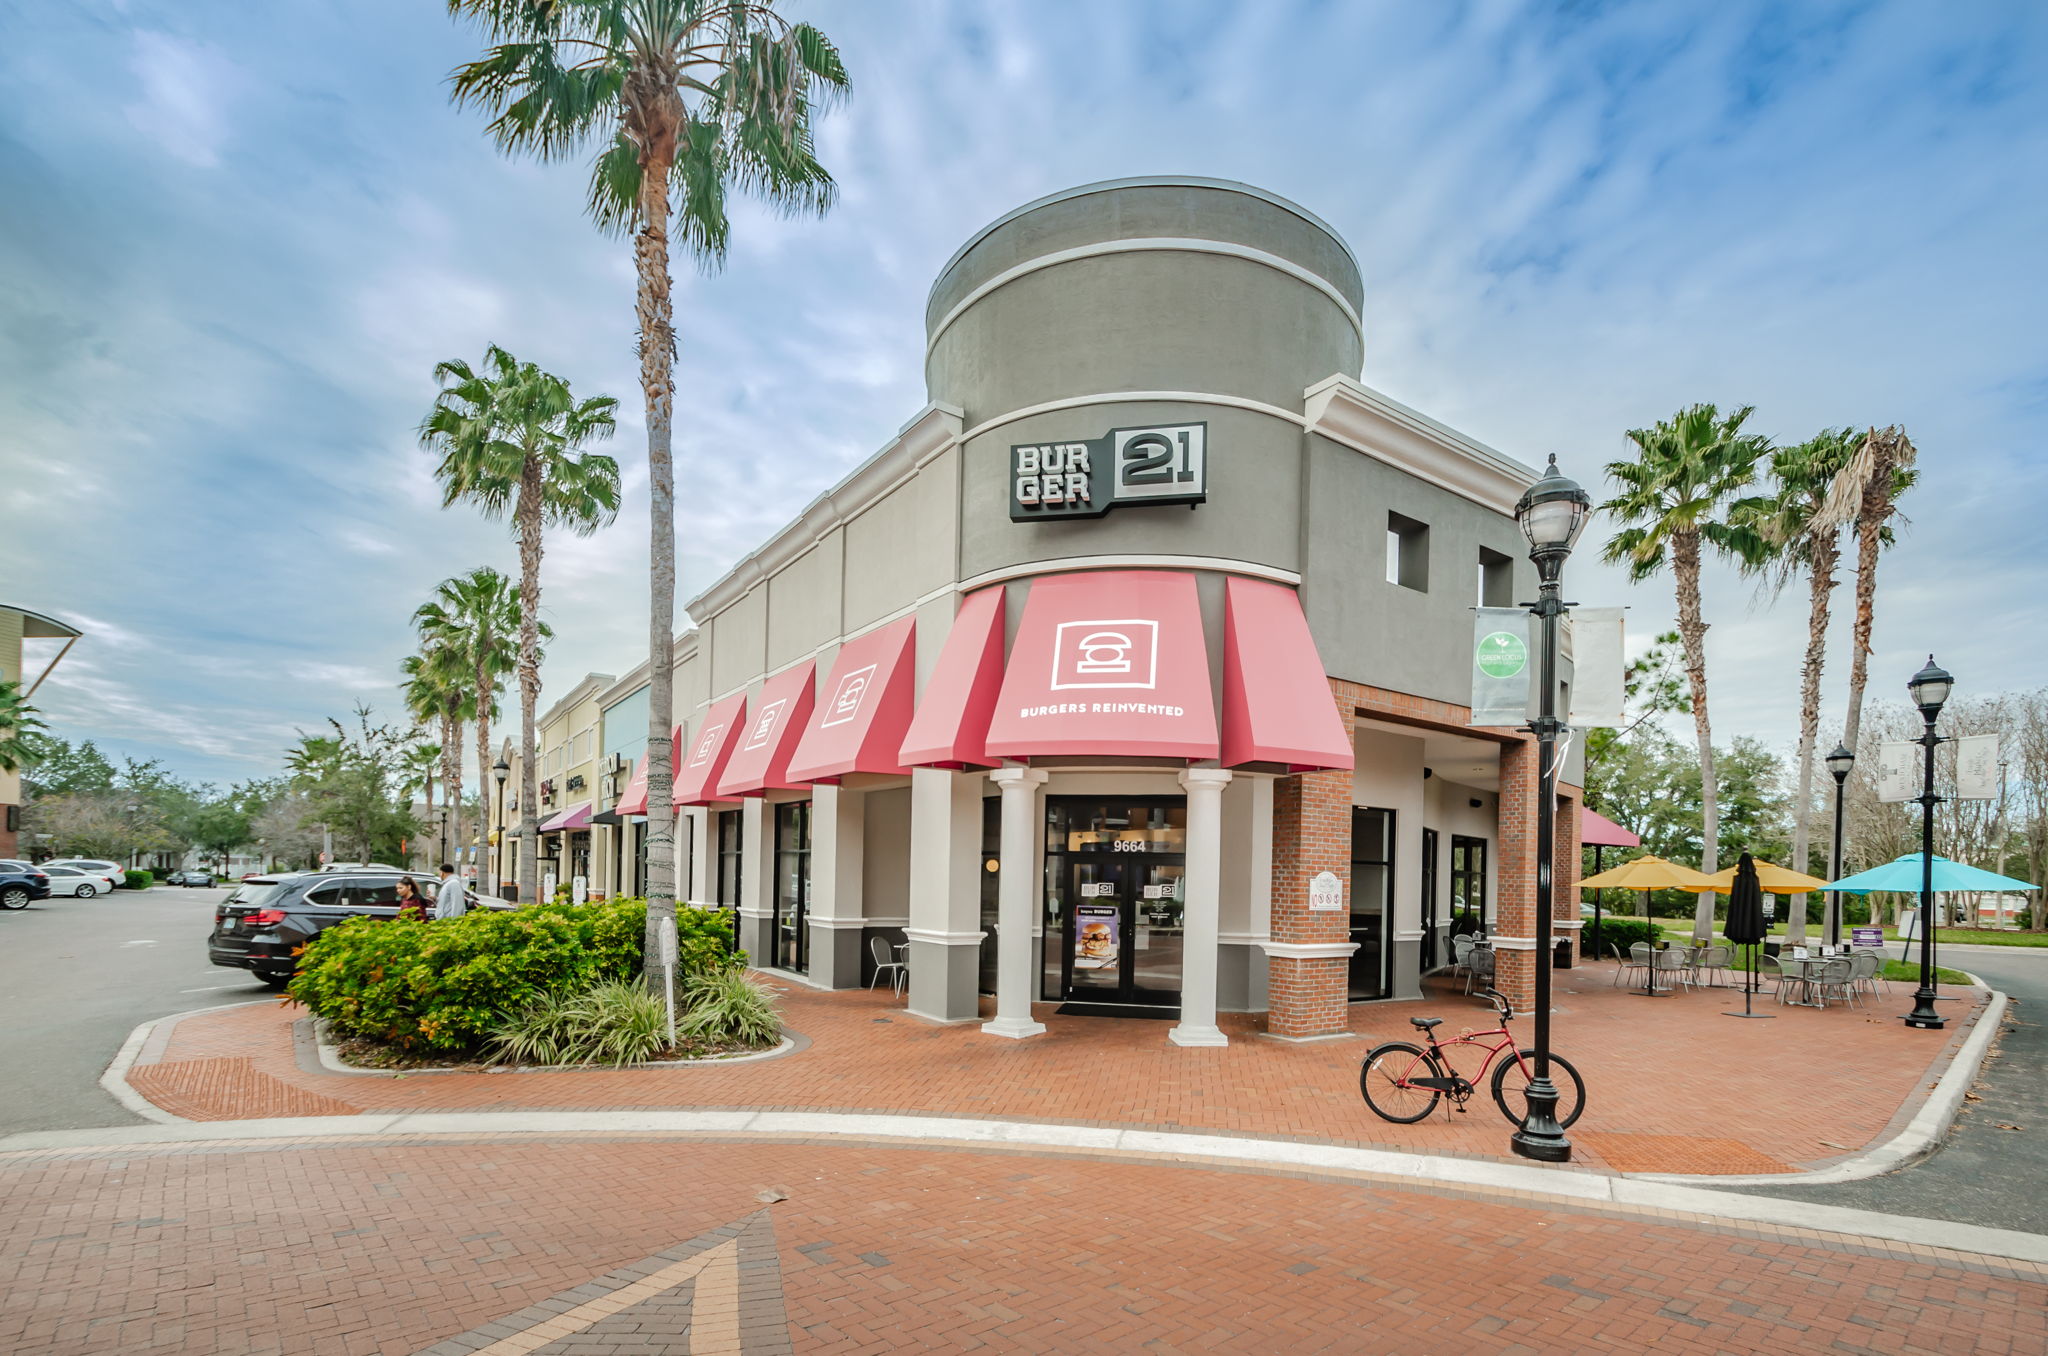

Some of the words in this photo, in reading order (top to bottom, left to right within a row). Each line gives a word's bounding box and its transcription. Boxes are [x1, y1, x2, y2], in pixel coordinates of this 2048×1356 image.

[1017, 443, 1090, 476] BUR
[1122, 431, 1194, 486] 21
[1016, 472, 1090, 505] GER
[1020, 703, 1087, 718] BURGERS
[1092, 703, 1184, 717] REINVENTED
[1113, 840, 1146, 853] 9664
